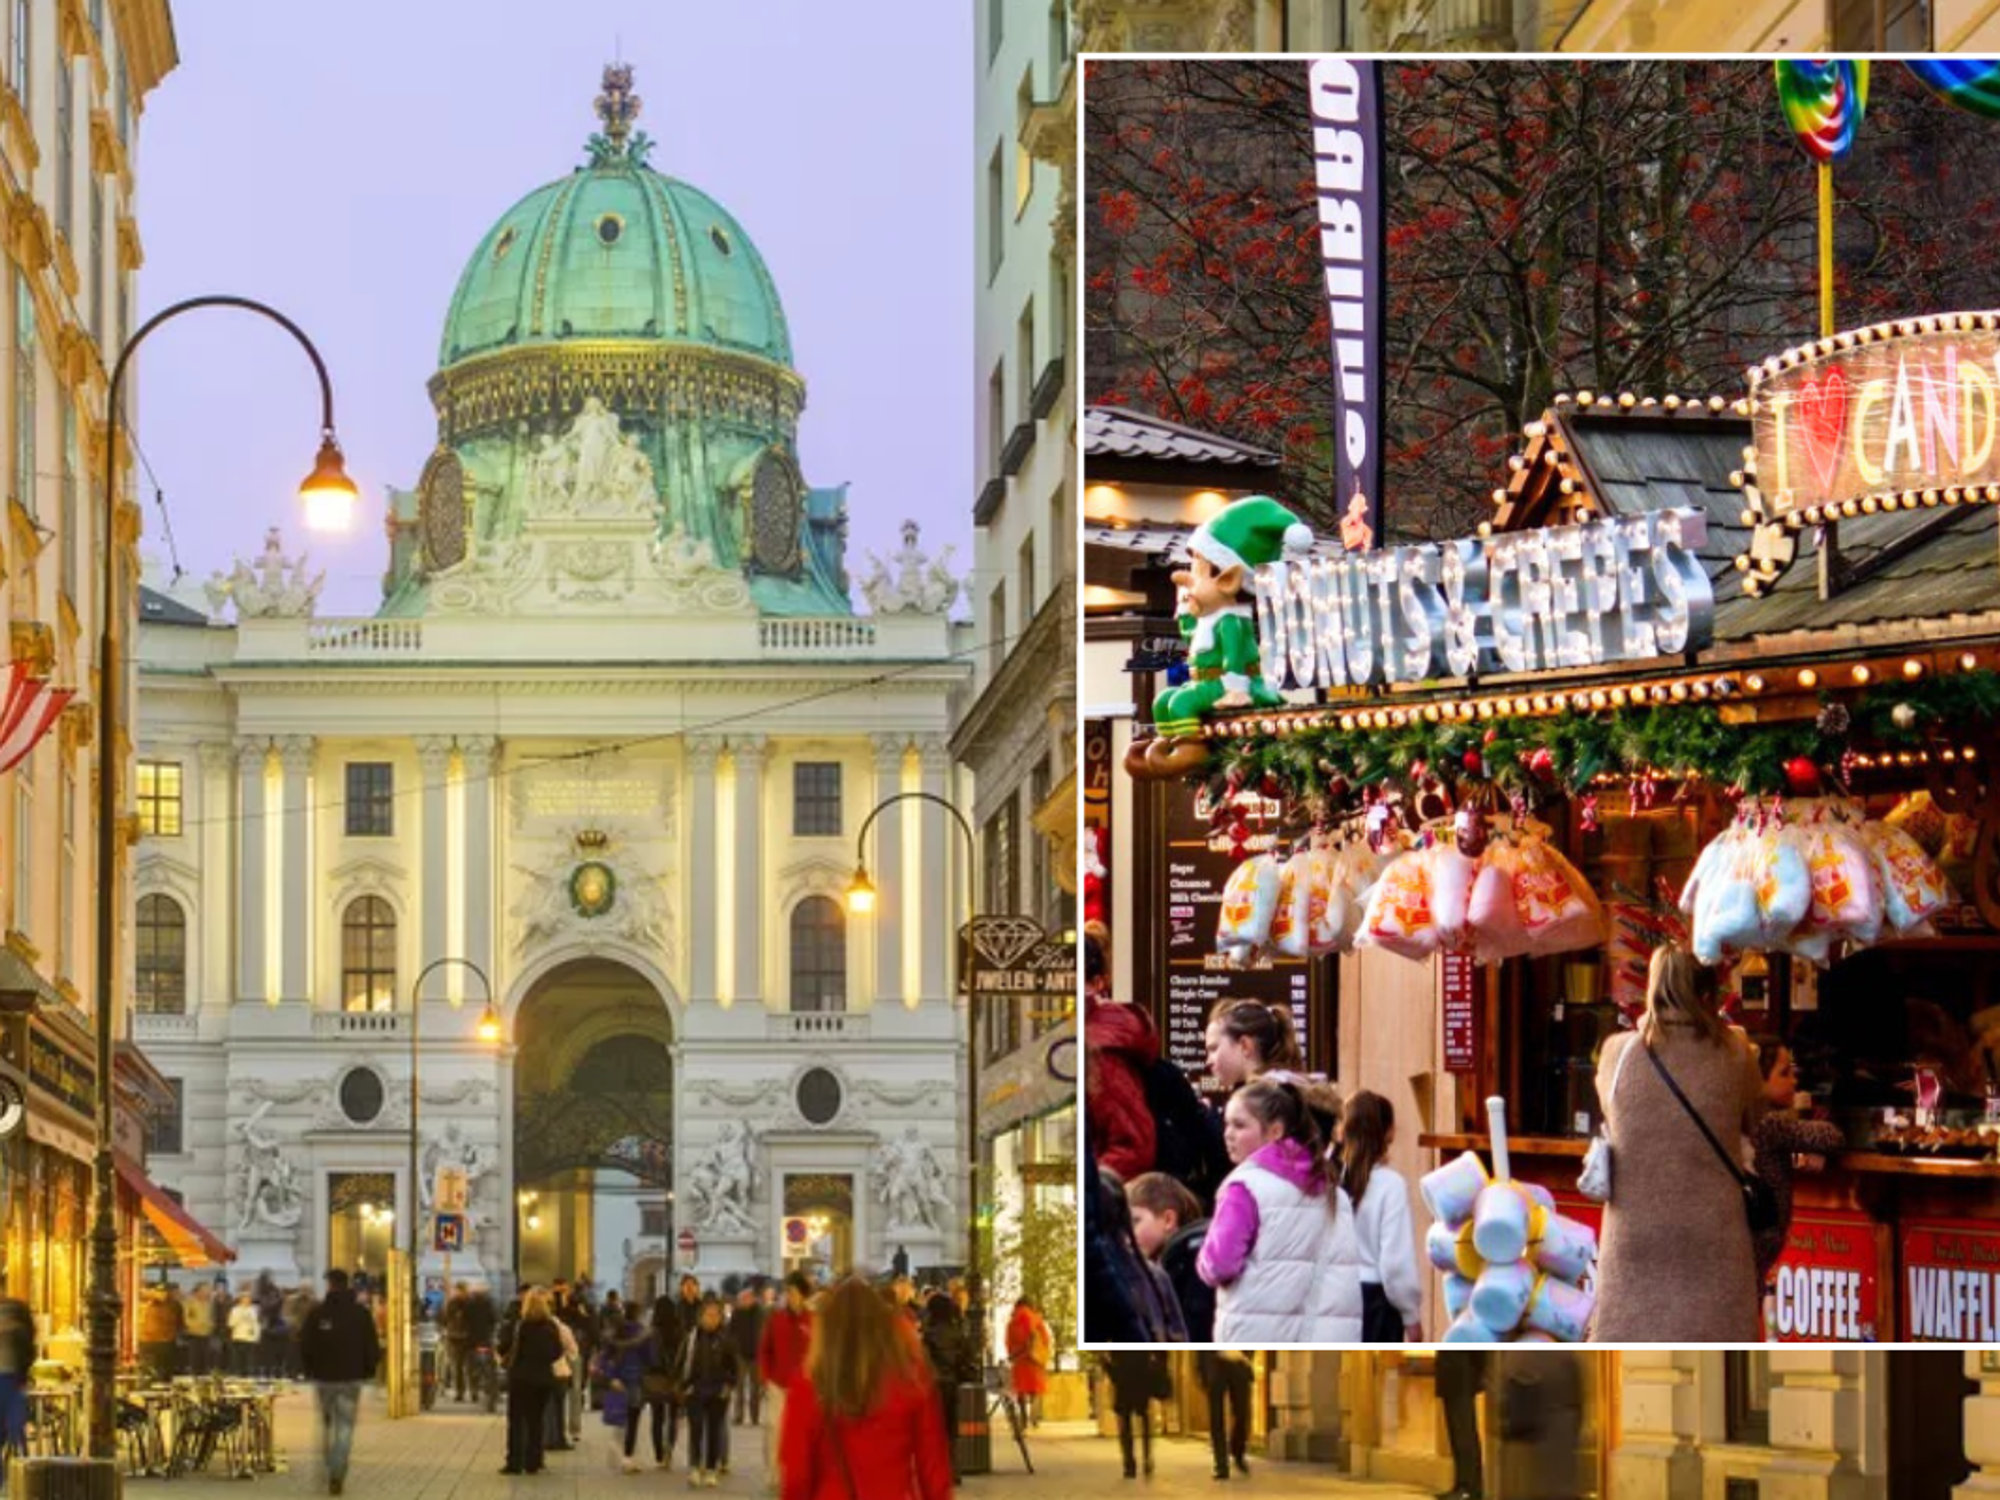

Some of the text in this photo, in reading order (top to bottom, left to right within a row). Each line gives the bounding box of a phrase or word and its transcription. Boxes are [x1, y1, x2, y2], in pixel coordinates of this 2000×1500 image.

[1853, 345, 2000, 487] CAND
[1254, 546, 1438, 692] DONUTS
[1489, 507, 1706, 673] CREPES
[1776, 1264, 1861, 1341] COFFEE
